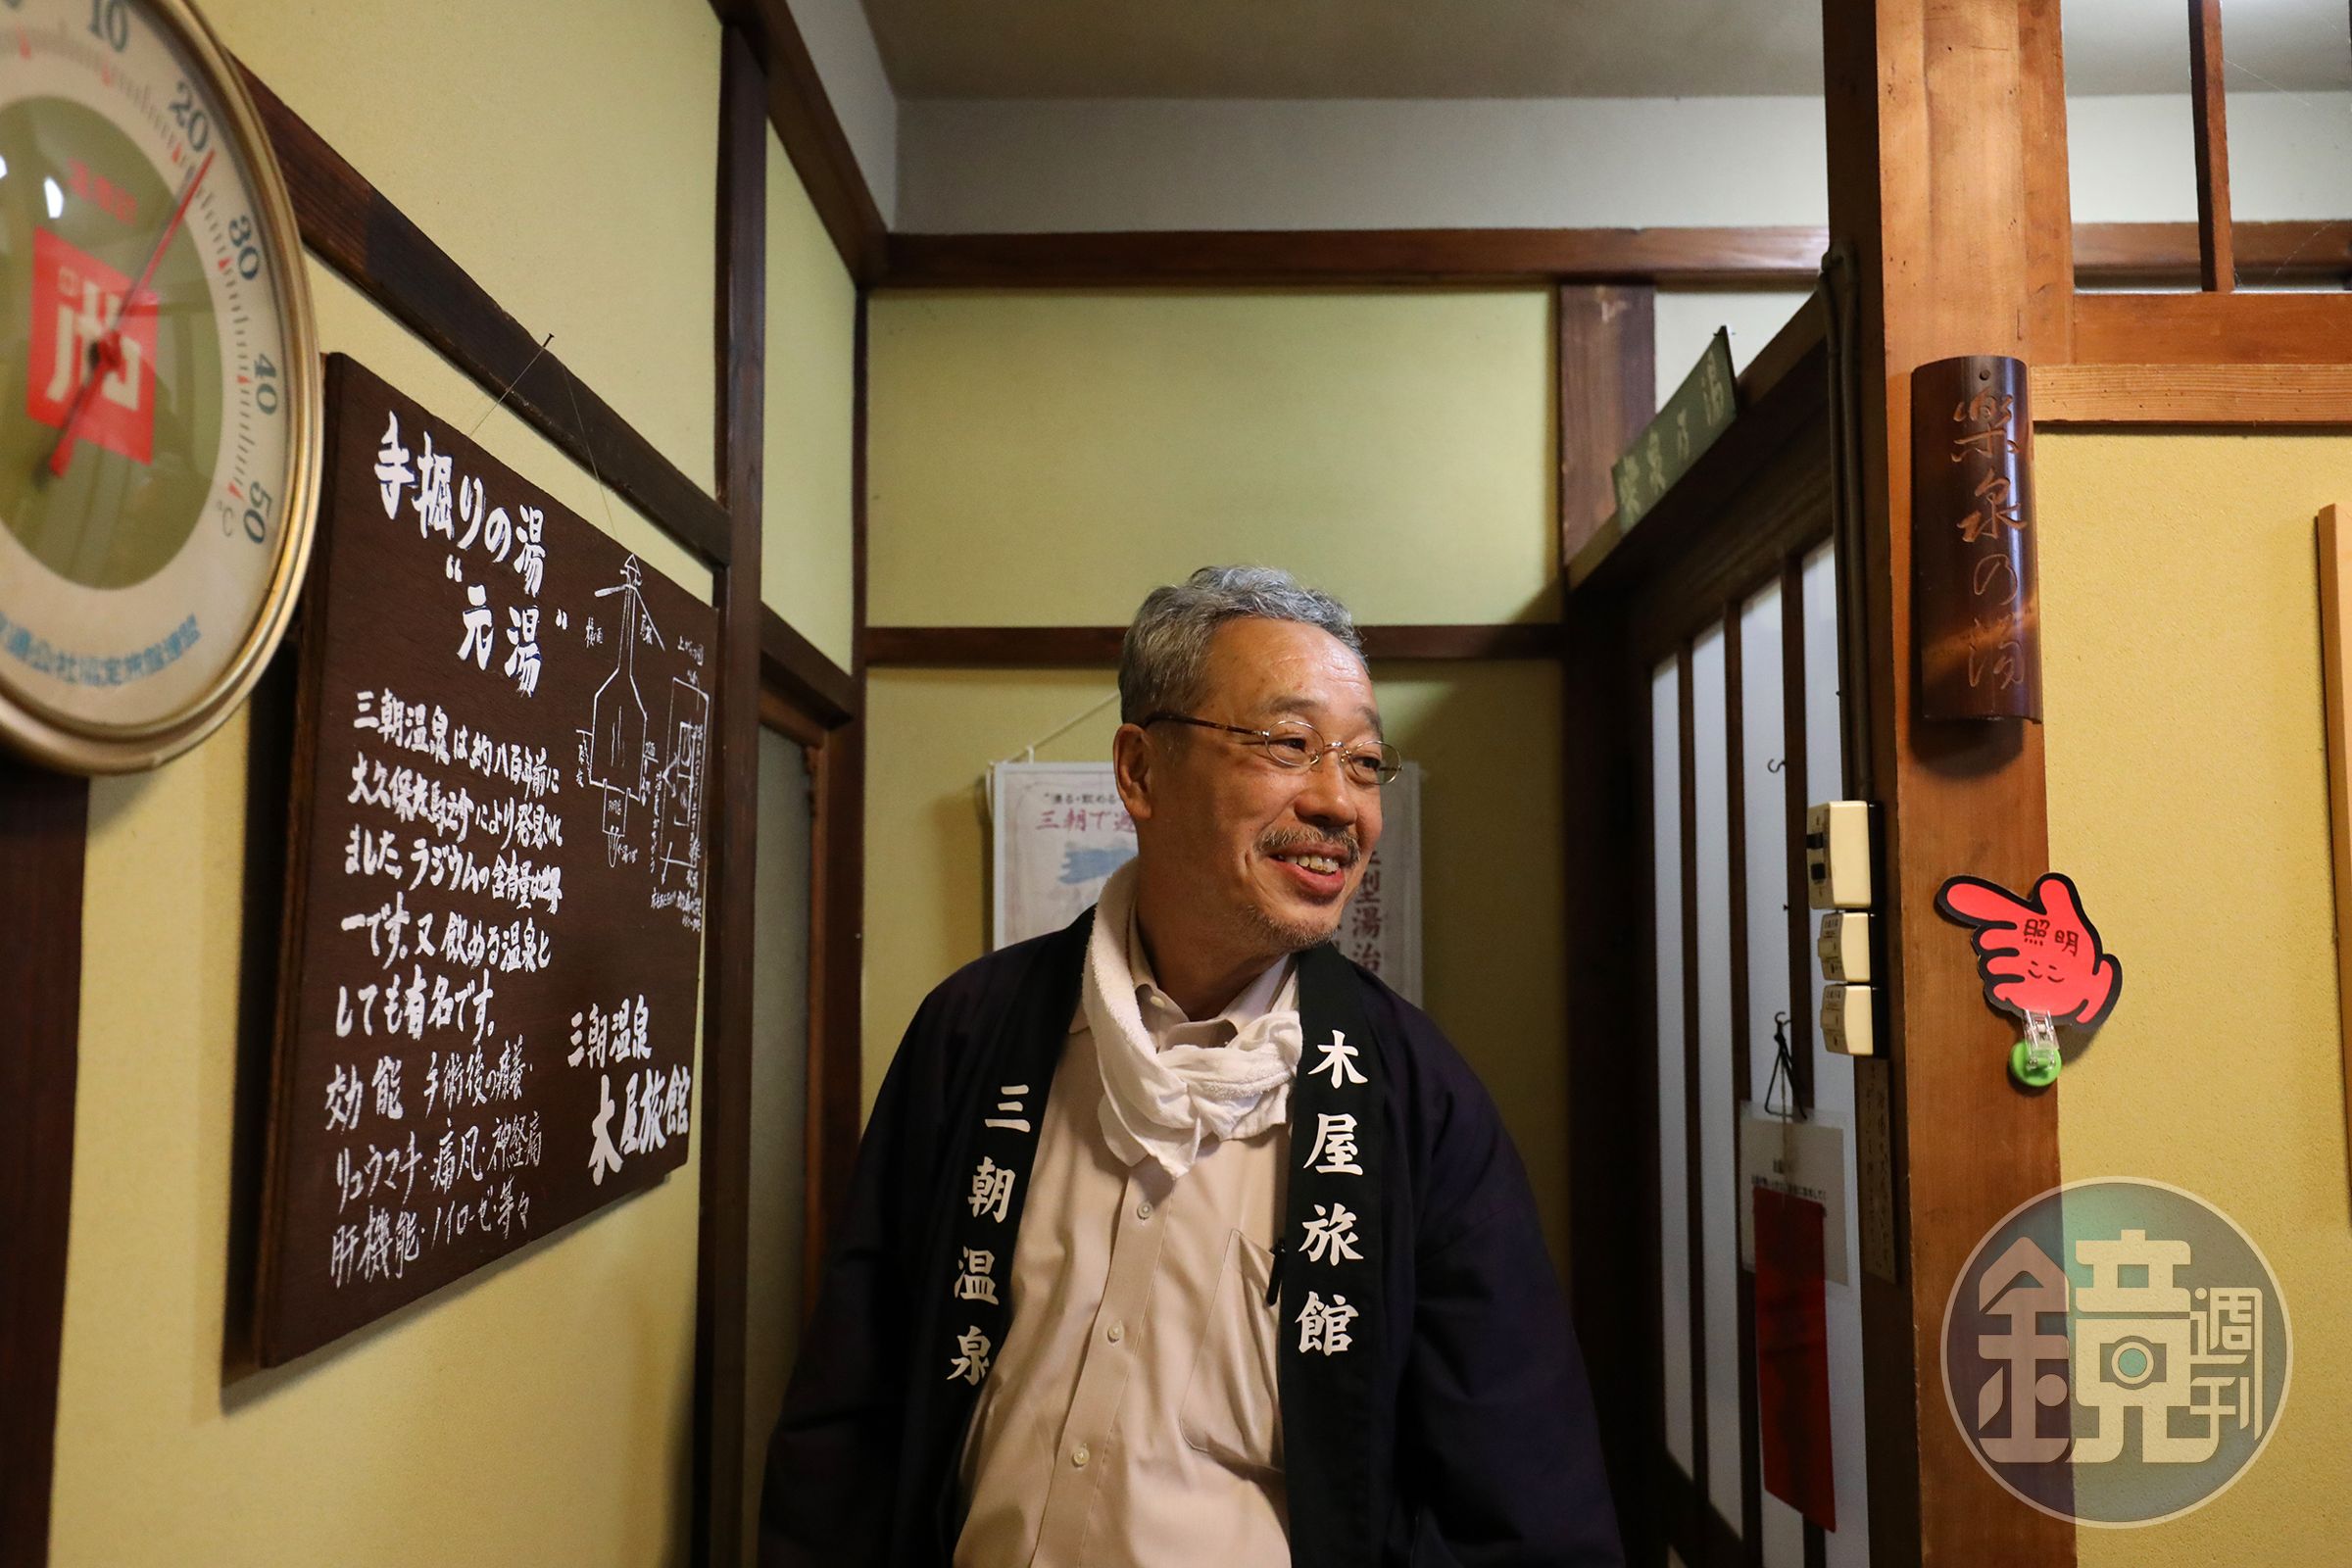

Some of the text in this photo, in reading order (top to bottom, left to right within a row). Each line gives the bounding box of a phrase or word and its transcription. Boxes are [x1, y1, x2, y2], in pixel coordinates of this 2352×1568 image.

[169, 80, 209, 152] 20
[228, 223, 260, 281] 30
[254, 353, 278, 416] 40
[242, 481, 273, 546] 50
[2023, 918, 2080, 956] 照明
[567, 995, 654, 1070] 三朝温泉
[588, 1063, 692, 1186] 木屋旅館
[1294, 1029, 1369, 1356] 木屋旅館
[947, 1083, 1032, 1386] 三朝温泉
